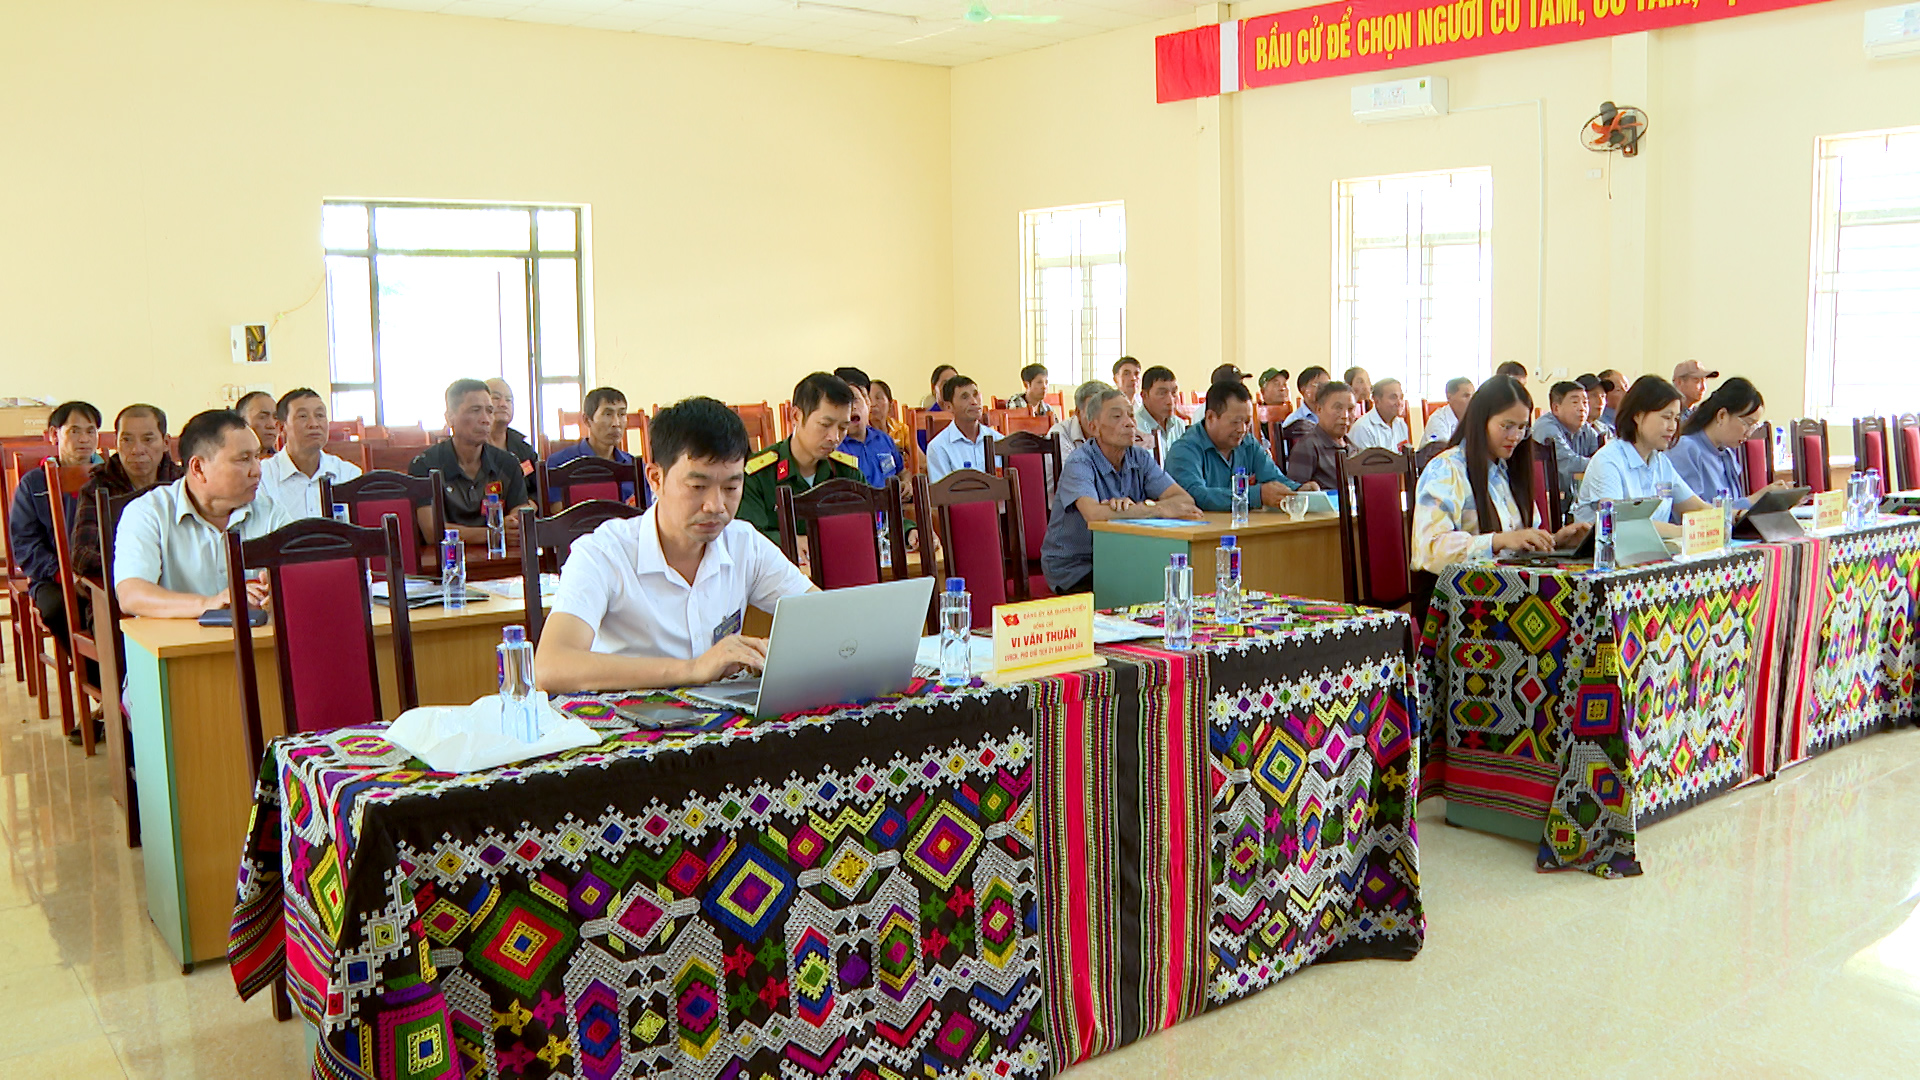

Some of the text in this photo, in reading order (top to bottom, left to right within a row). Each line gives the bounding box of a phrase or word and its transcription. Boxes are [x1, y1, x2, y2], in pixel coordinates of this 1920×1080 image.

[1297, 15, 1324, 65] CỬ
[1327, 6, 1352, 60] ĐỂ
[1357, 11, 1412, 60] CHỌN
[1011, 637, 1021, 648] VI
